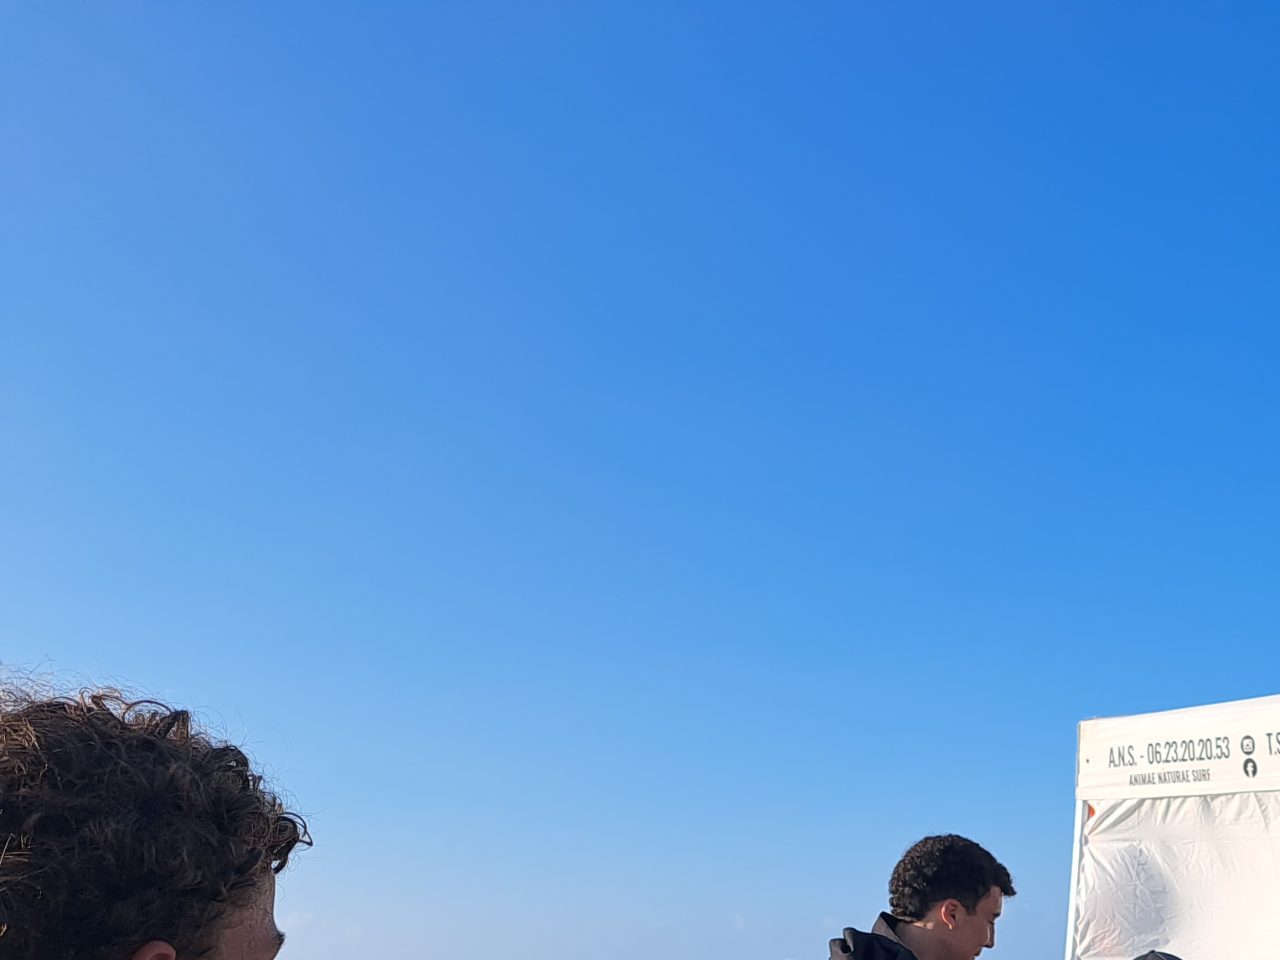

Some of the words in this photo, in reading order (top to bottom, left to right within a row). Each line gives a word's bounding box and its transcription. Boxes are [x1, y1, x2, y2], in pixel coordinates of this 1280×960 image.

[1108, 745, 1138, 768] A.N.S.
[1147, 736, 1230, 765] 06.23.20.20.53
[1129, 772, 1157, 787] ANIMAE
[1157, 770, 1191, 785] NATURAE
[1192, 768, 1211, 782] SURF
